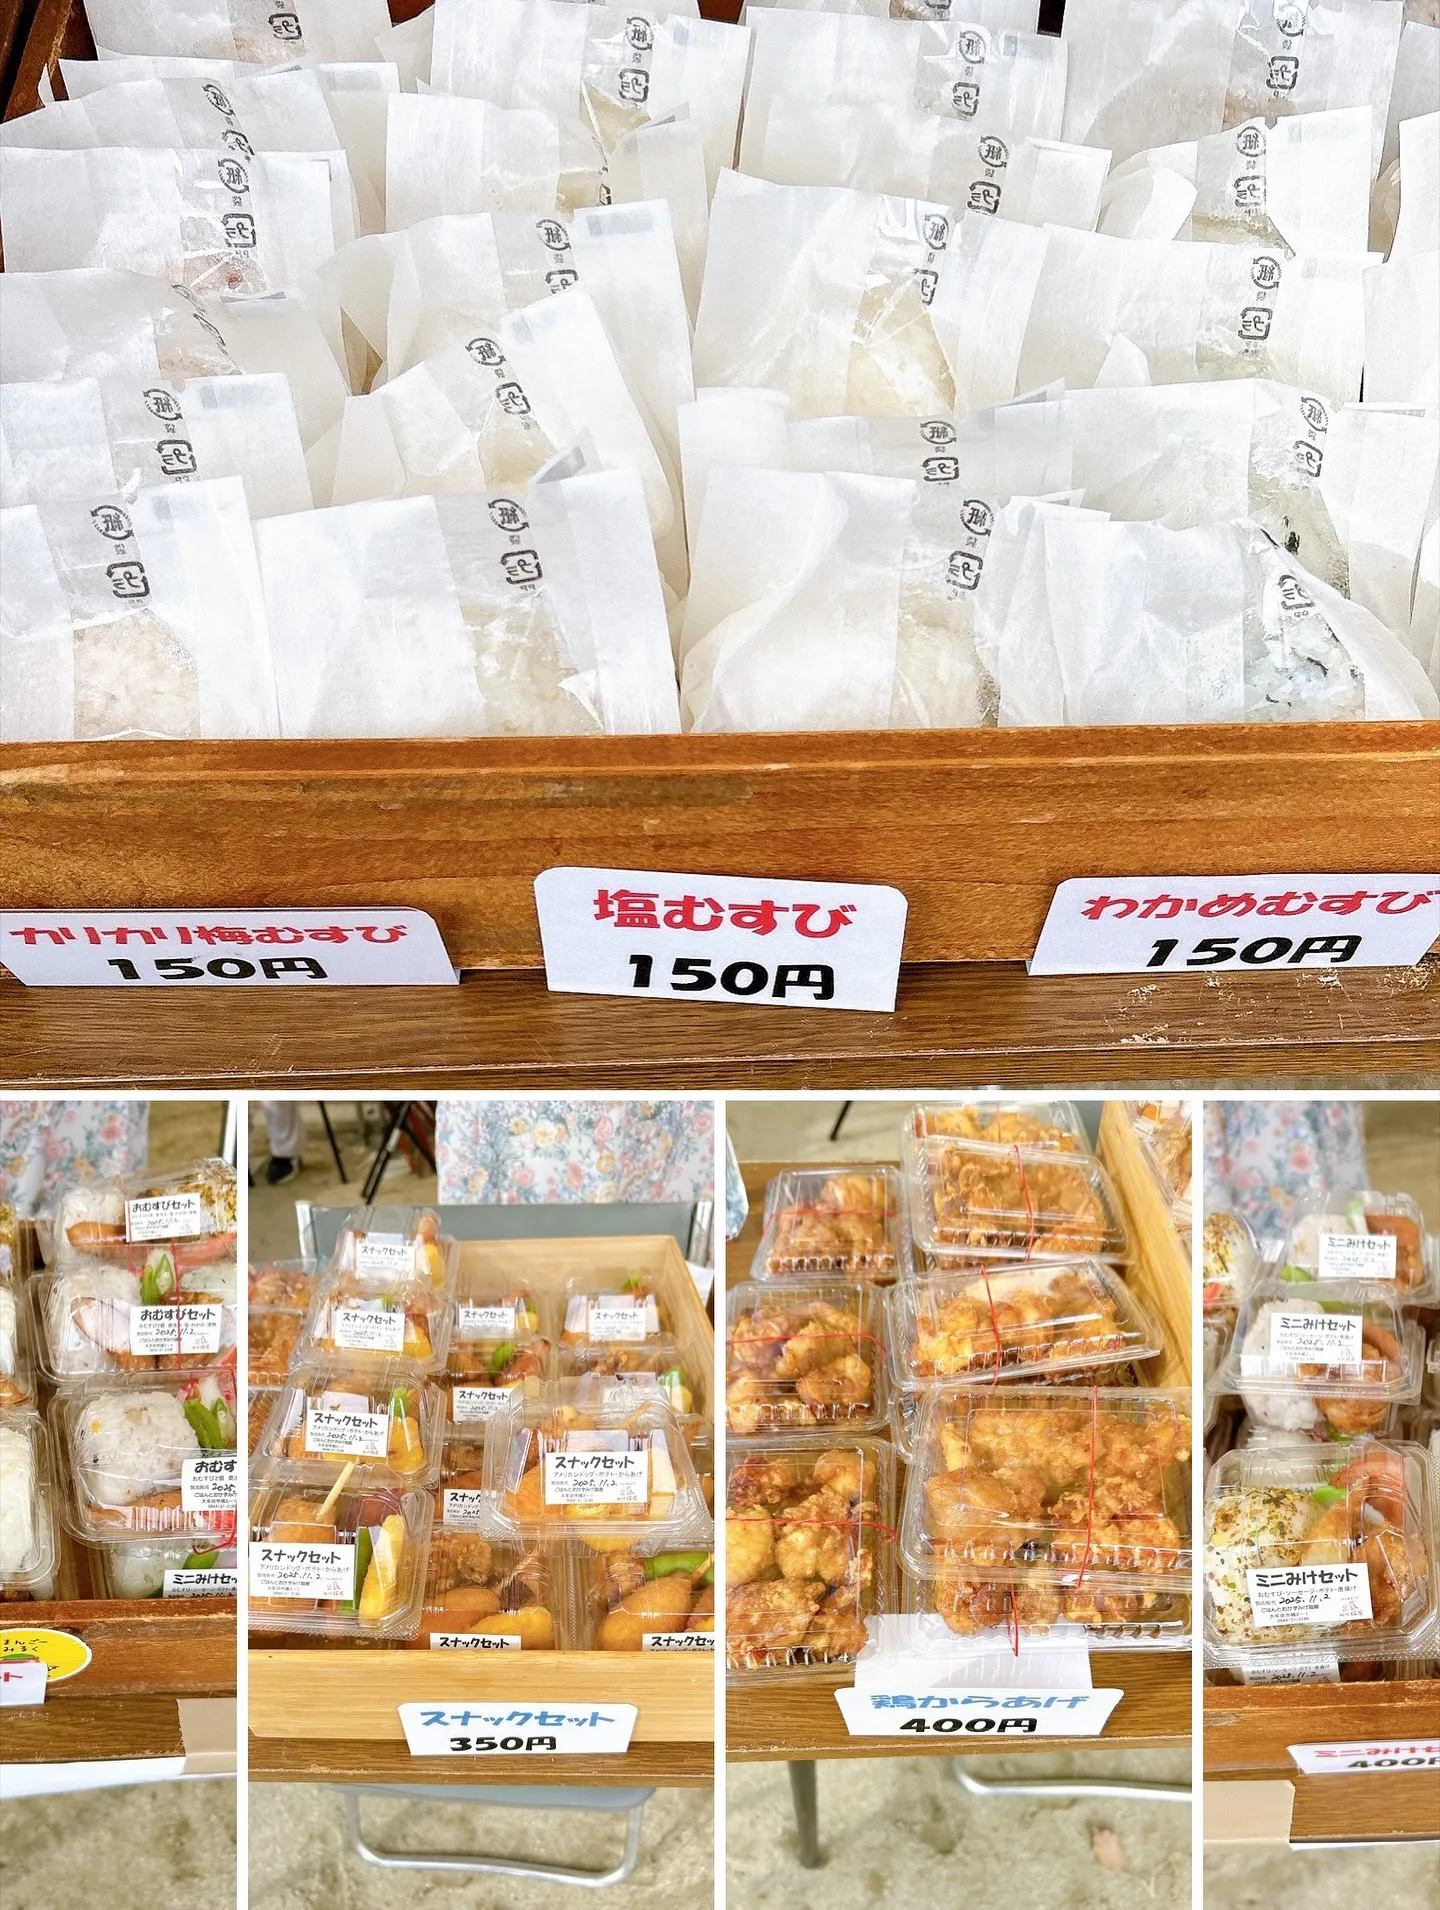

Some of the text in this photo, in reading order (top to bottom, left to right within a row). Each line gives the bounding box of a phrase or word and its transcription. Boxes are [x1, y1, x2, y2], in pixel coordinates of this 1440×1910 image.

[1081, 889, 1440, 920] わかめむすび
[593, 889, 857, 938] 塩むすび
[10, 924, 407, 946] カリカリ梅むすび
[1146, 934, 1363, 967] 150円
[107, 956, 328, 980] 150円
[629, 954, 834, 1000] 150円
[132, 1199, 196, 1213] おむすびセット
[1328, 1237, 1391, 1250] ミニみけセット
[361, 1246, 407, 1256] スナックセット
[140, 1308, 216, 1321] おむすびセット
[343, 1312, 396, 1325] スナックセット
[464, 1311, 507, 1319] スナックセット
[595, 1311, 639, 1320] スナックセット
[1280, 1317, 1356, 1332] ミニみけセット
[459, 1390, 508, 1401] スナックセット
[314, 1412, 378, 1428] スナックセット
[194, 1459, 237, 1473] おむす
[555, 1456, 634, 1469] スナックセット
[573, 1479, 617, 1487] 2025.11.2
[261, 1549, 341, 1564] スナックセット
[1256, 1568, 1358, 1588] ミニみけセット
[1279, 1594, 1331, 1604] 2025.11.2
[439, 1636, 510, 1649] スナックセット
[870, 1695, 1090, 1709] 鶏からあげ
[420, 1711, 615, 1727] スナックセット
[899, 1718, 1038, 1733] 400円
[449, 1736, 557, 1752] 350円
